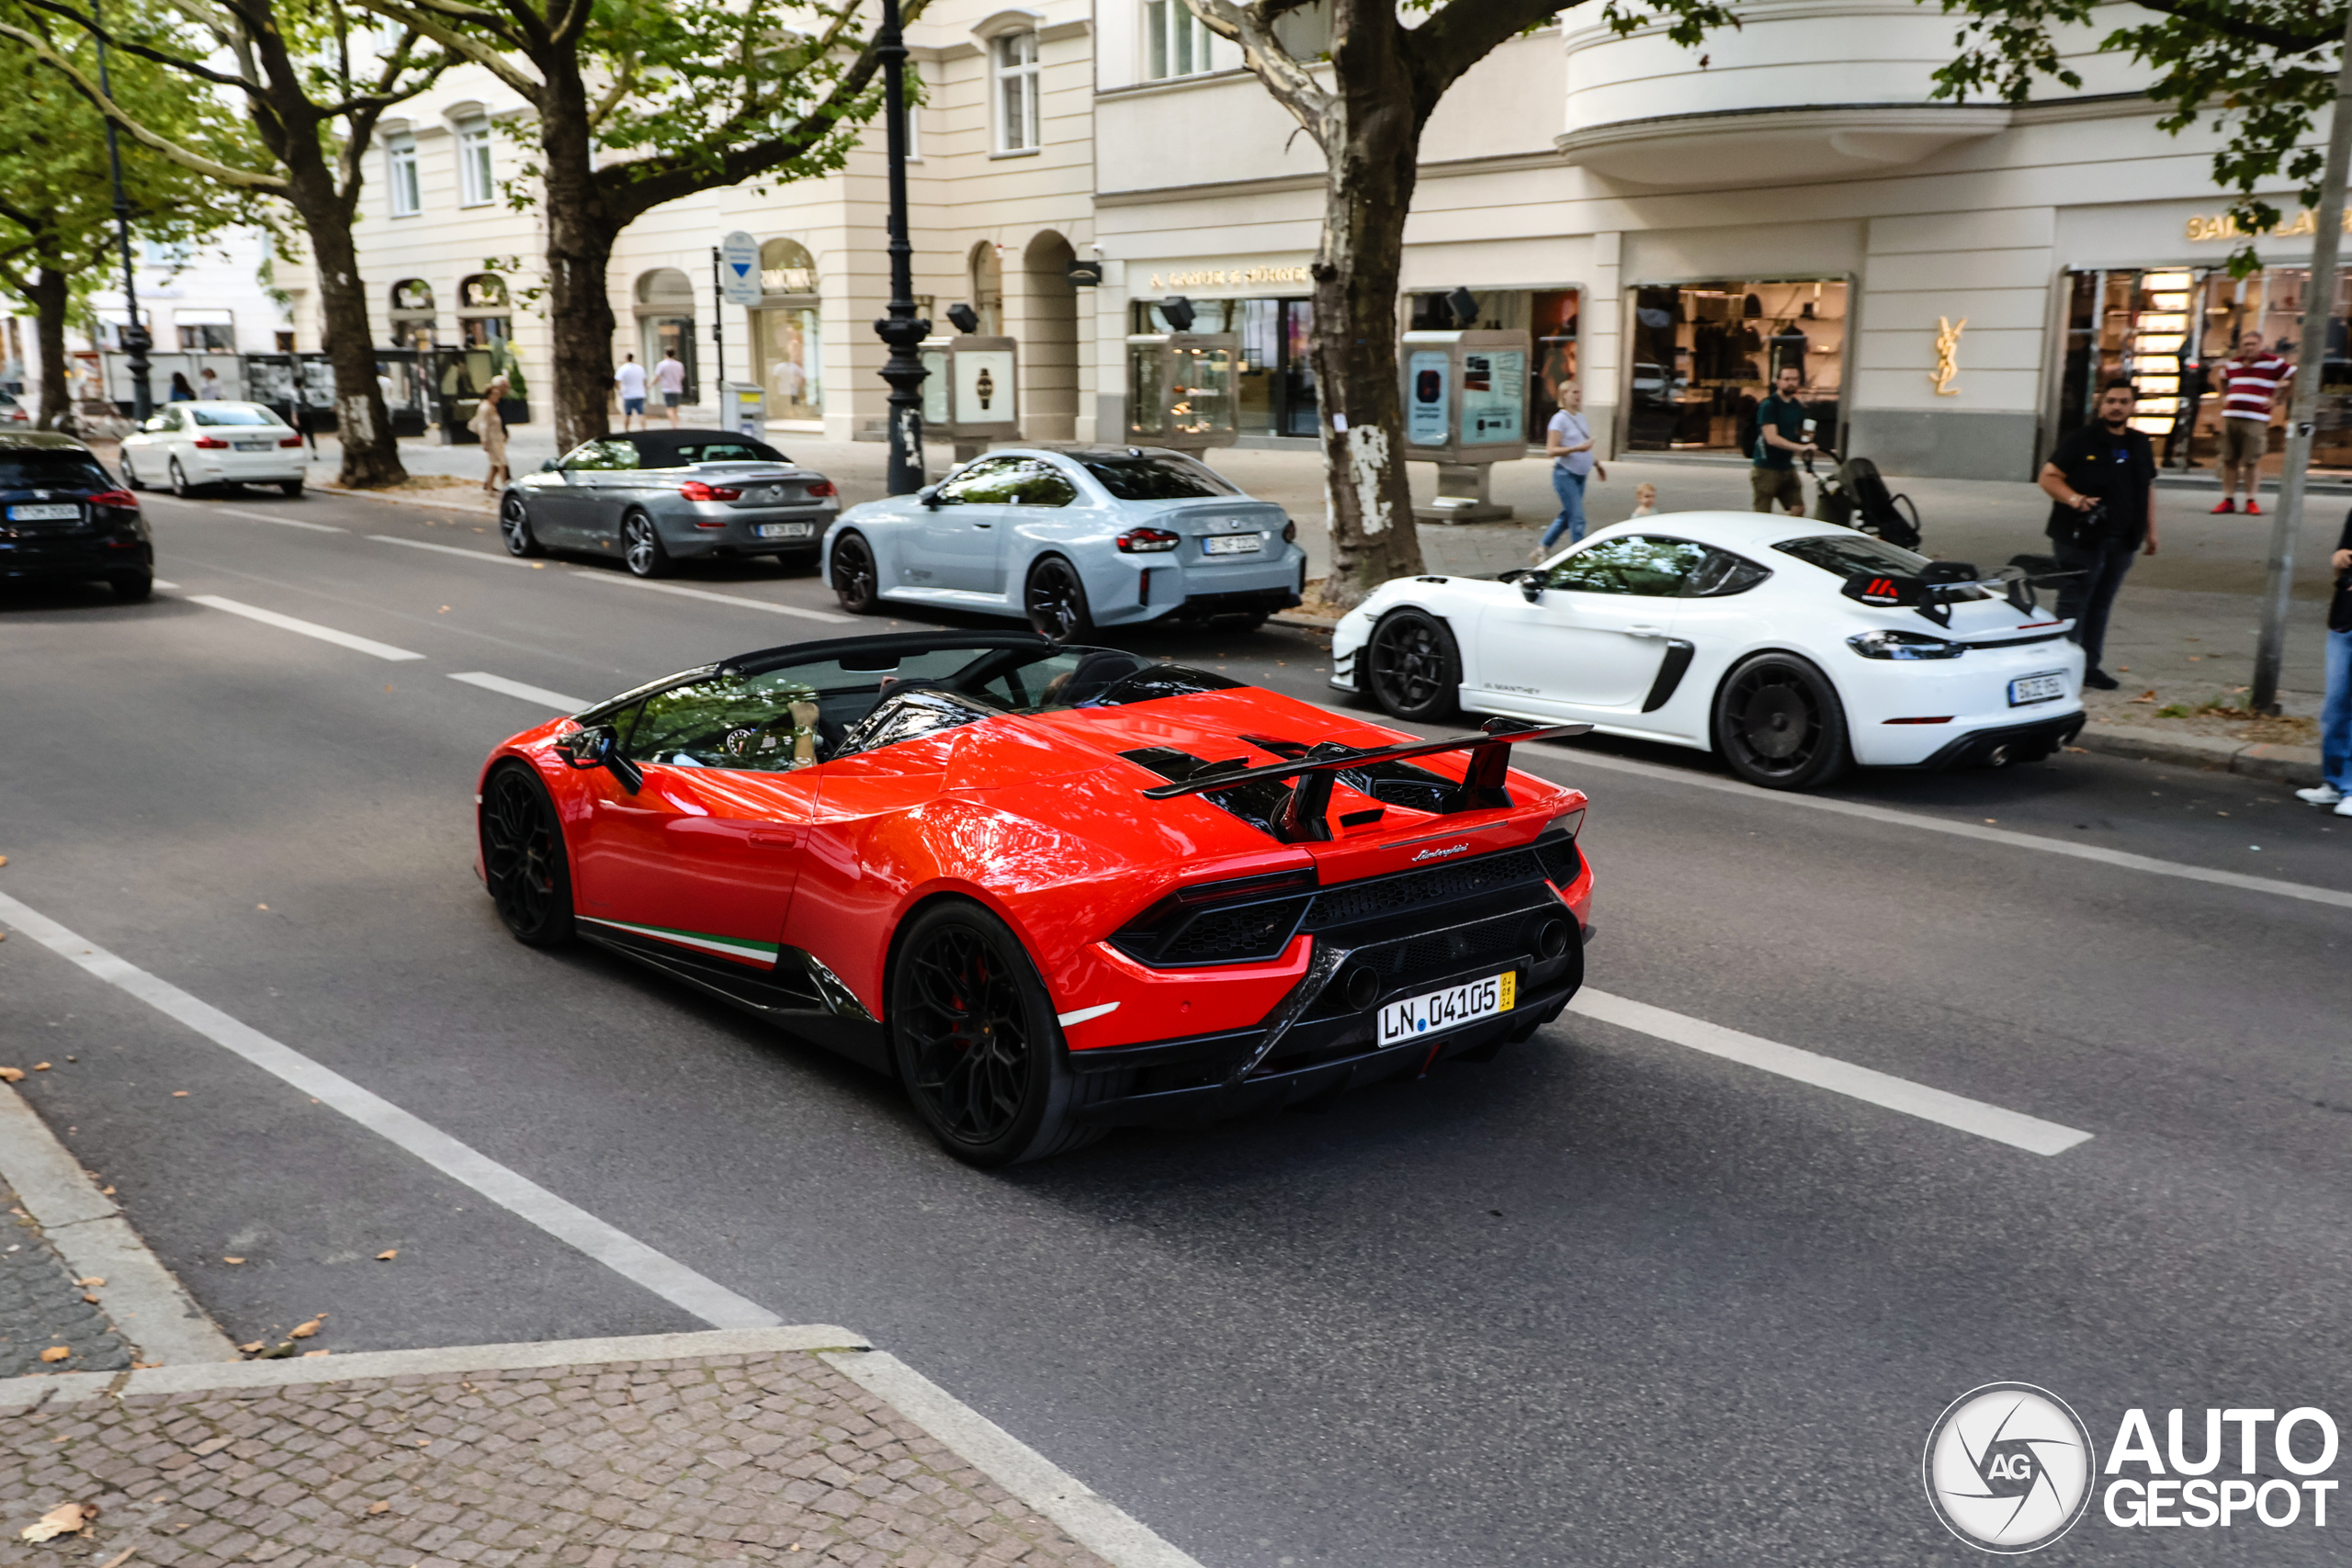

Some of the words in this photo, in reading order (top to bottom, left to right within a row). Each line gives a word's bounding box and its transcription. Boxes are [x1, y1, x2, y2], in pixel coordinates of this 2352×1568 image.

[1411, 842, 1469, 862] Lamborghini
[1502, 976, 1511, 987] 04
[1385, 1001, 1414, 1040] LN
[1430, 980, 1496, 1027] 04105
[1501, 996, 1510, 1008] 24
